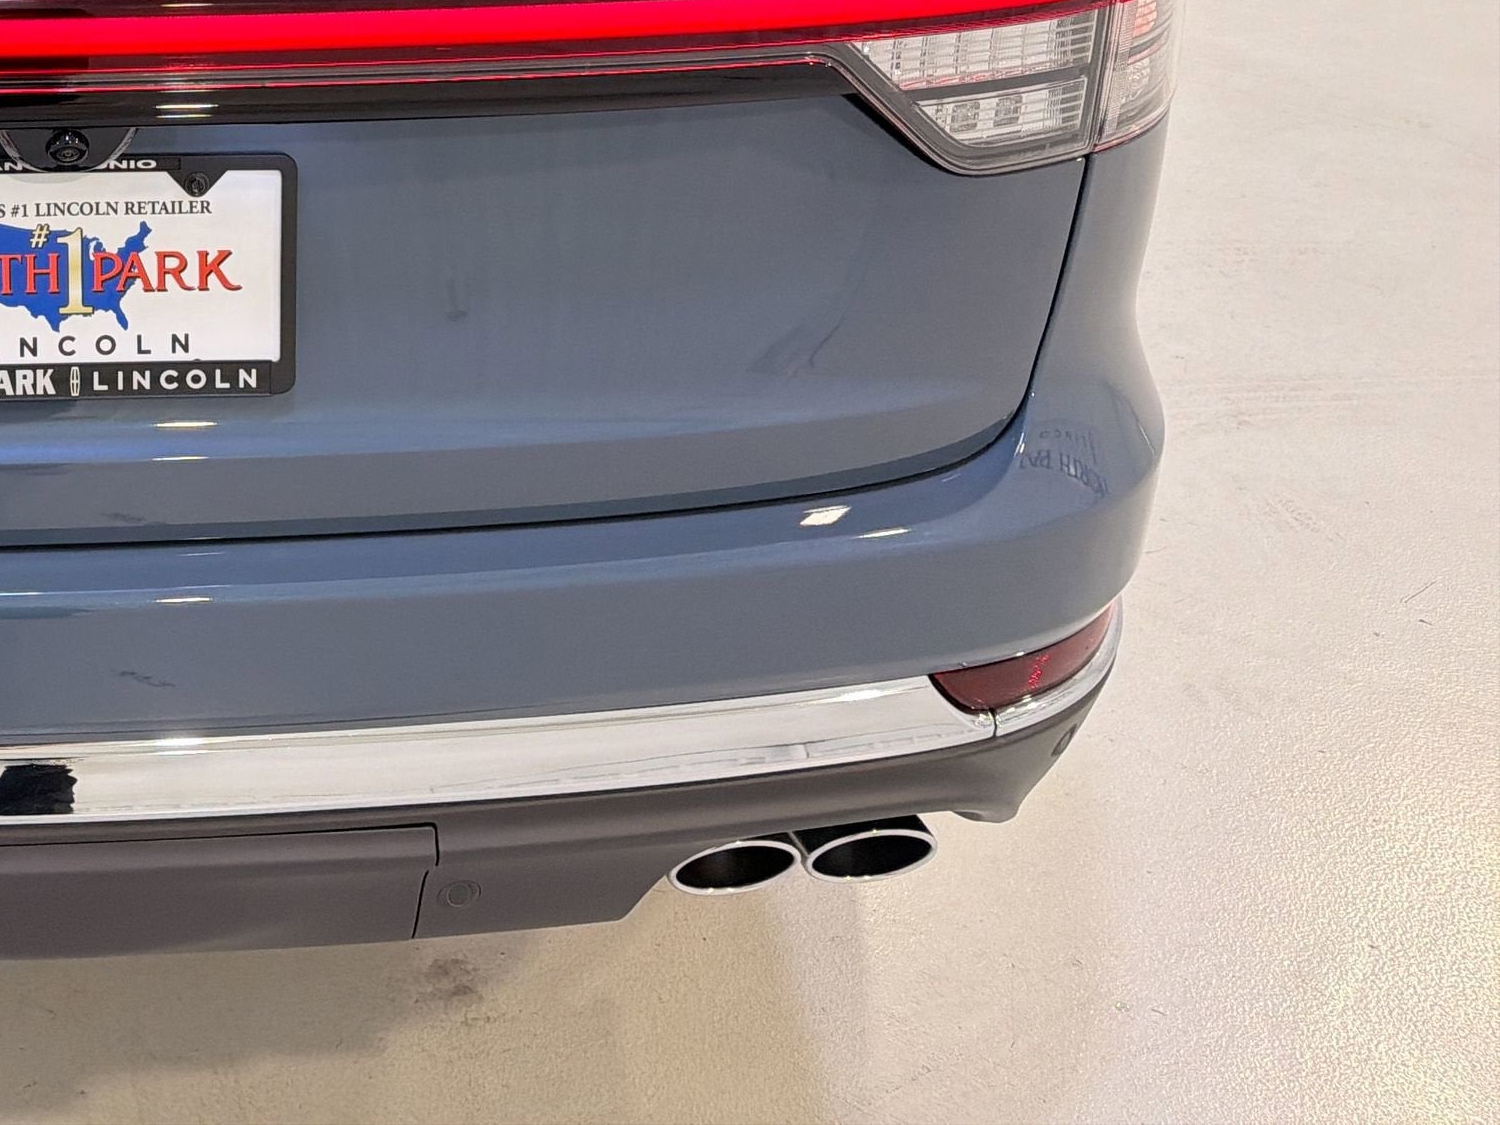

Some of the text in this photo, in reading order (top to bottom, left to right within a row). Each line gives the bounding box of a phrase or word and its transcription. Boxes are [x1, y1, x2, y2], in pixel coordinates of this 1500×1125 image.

[11, 205, 29, 218] #1
[35, 200, 120, 218] LINCOLN
[123, 199, 213, 216] RETAILER
[92, 249, 243, 293] PARK
[92, 367, 258, 392] LINCOLN
